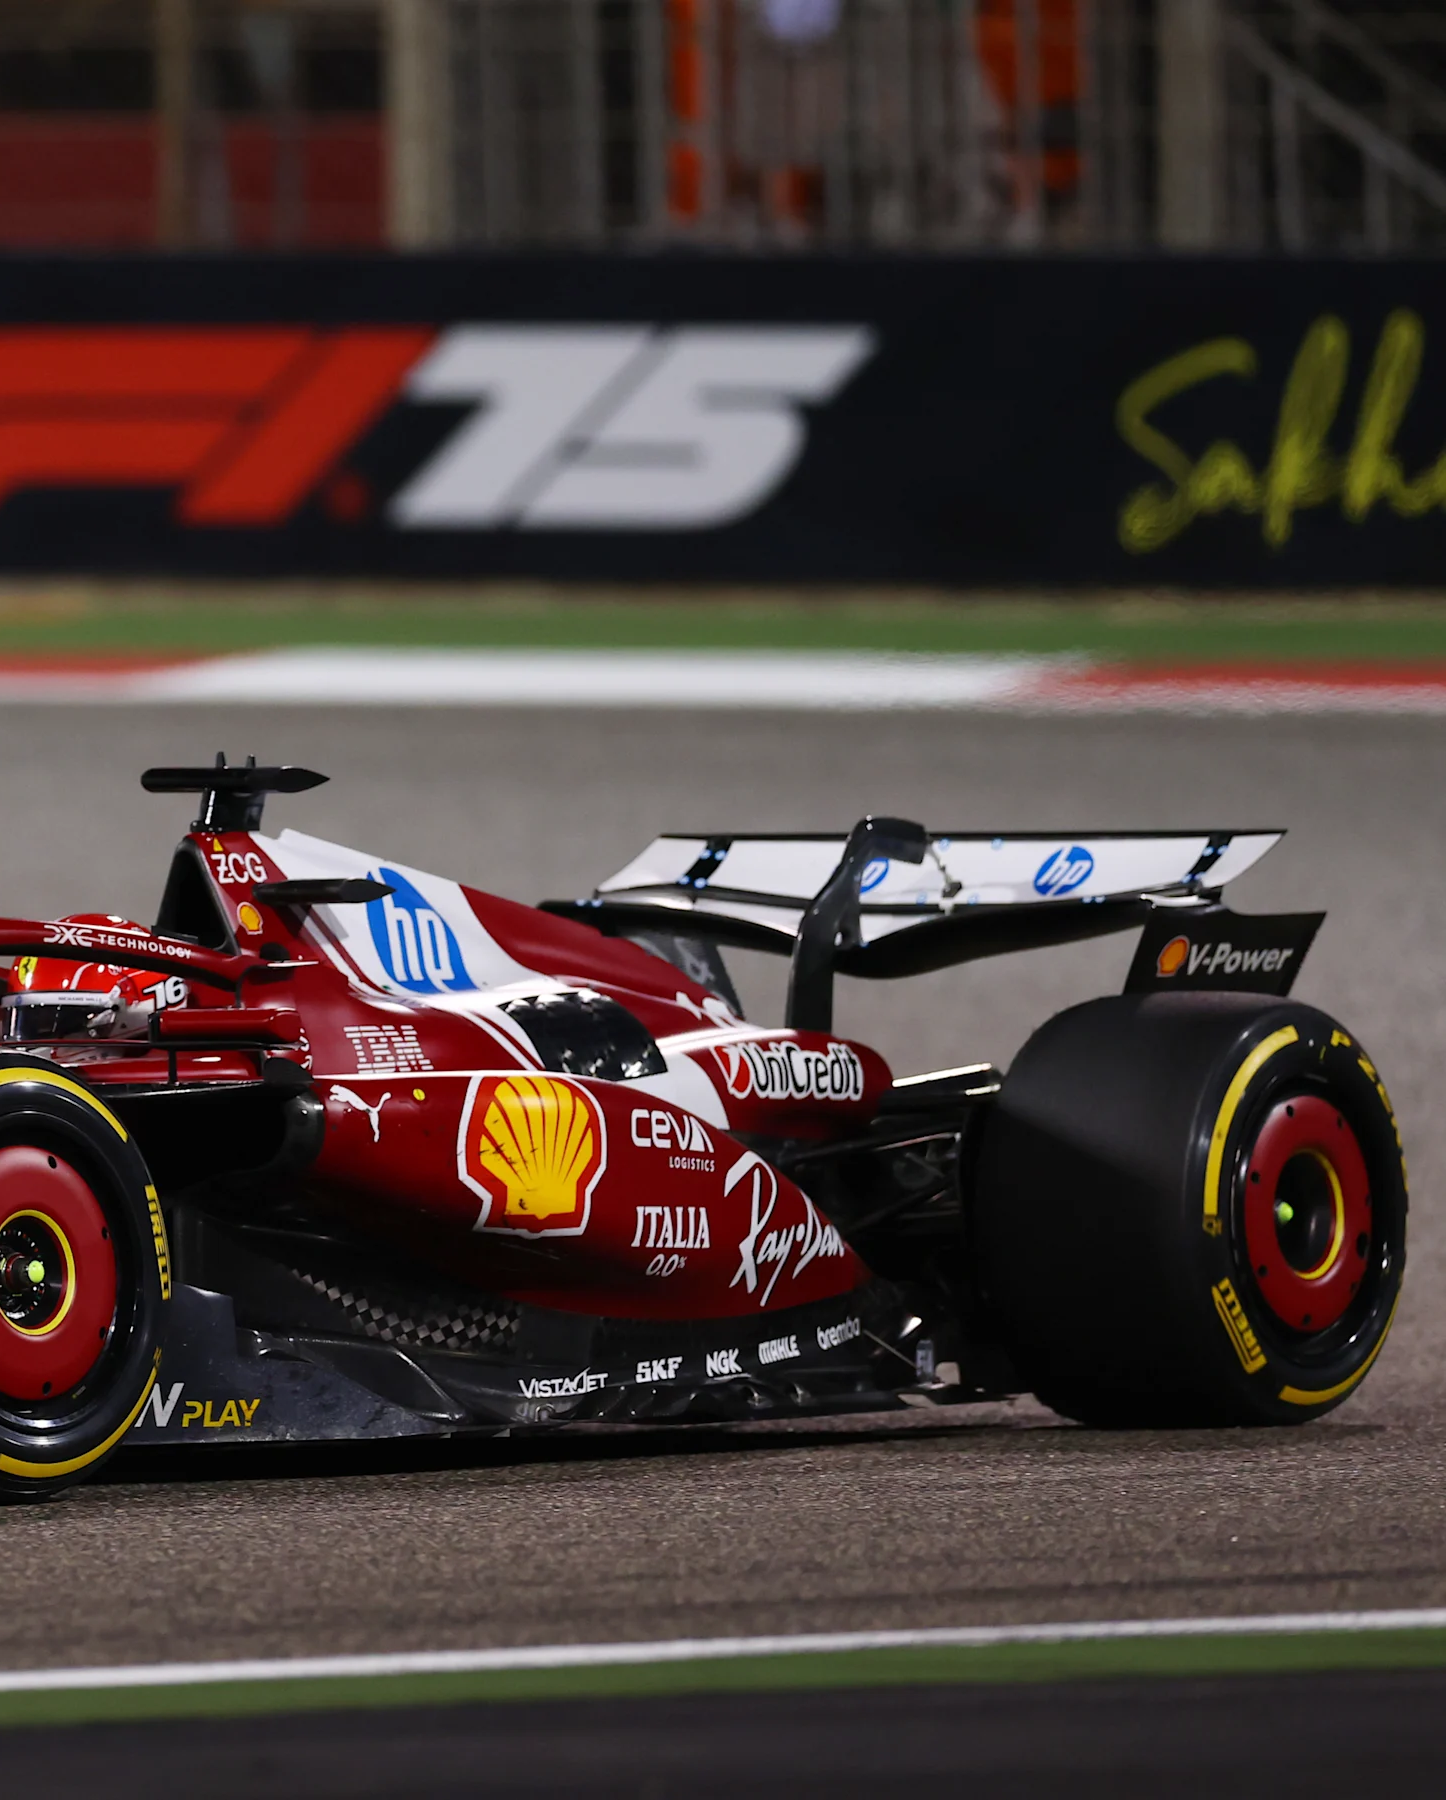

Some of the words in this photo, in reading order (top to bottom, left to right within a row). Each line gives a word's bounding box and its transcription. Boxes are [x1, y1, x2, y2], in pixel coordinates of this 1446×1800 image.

[1036, 845, 1094, 897] hp
[97, 933, 192, 960] TECHNOLOGY
[370, 866, 470, 993] hp
[1187, 942, 1293, 977] V-Power
[143, 976, 187, 1011] 16
[344, 1024, 434, 1074] IBM
[746, 1041, 864, 1100] UniCredit
[669, 1156, 715, 1173] LOGISTICS
[631, 1206, 710, 1249] ITALIA
[759, 1335, 800, 1365] MAHLE
[816, 1315, 861, 1351] brembo
[636, 1356, 682, 1384] SKF
[706, 1348, 742, 1378] NGK
[182, 1399, 261, 1428] PLAY
